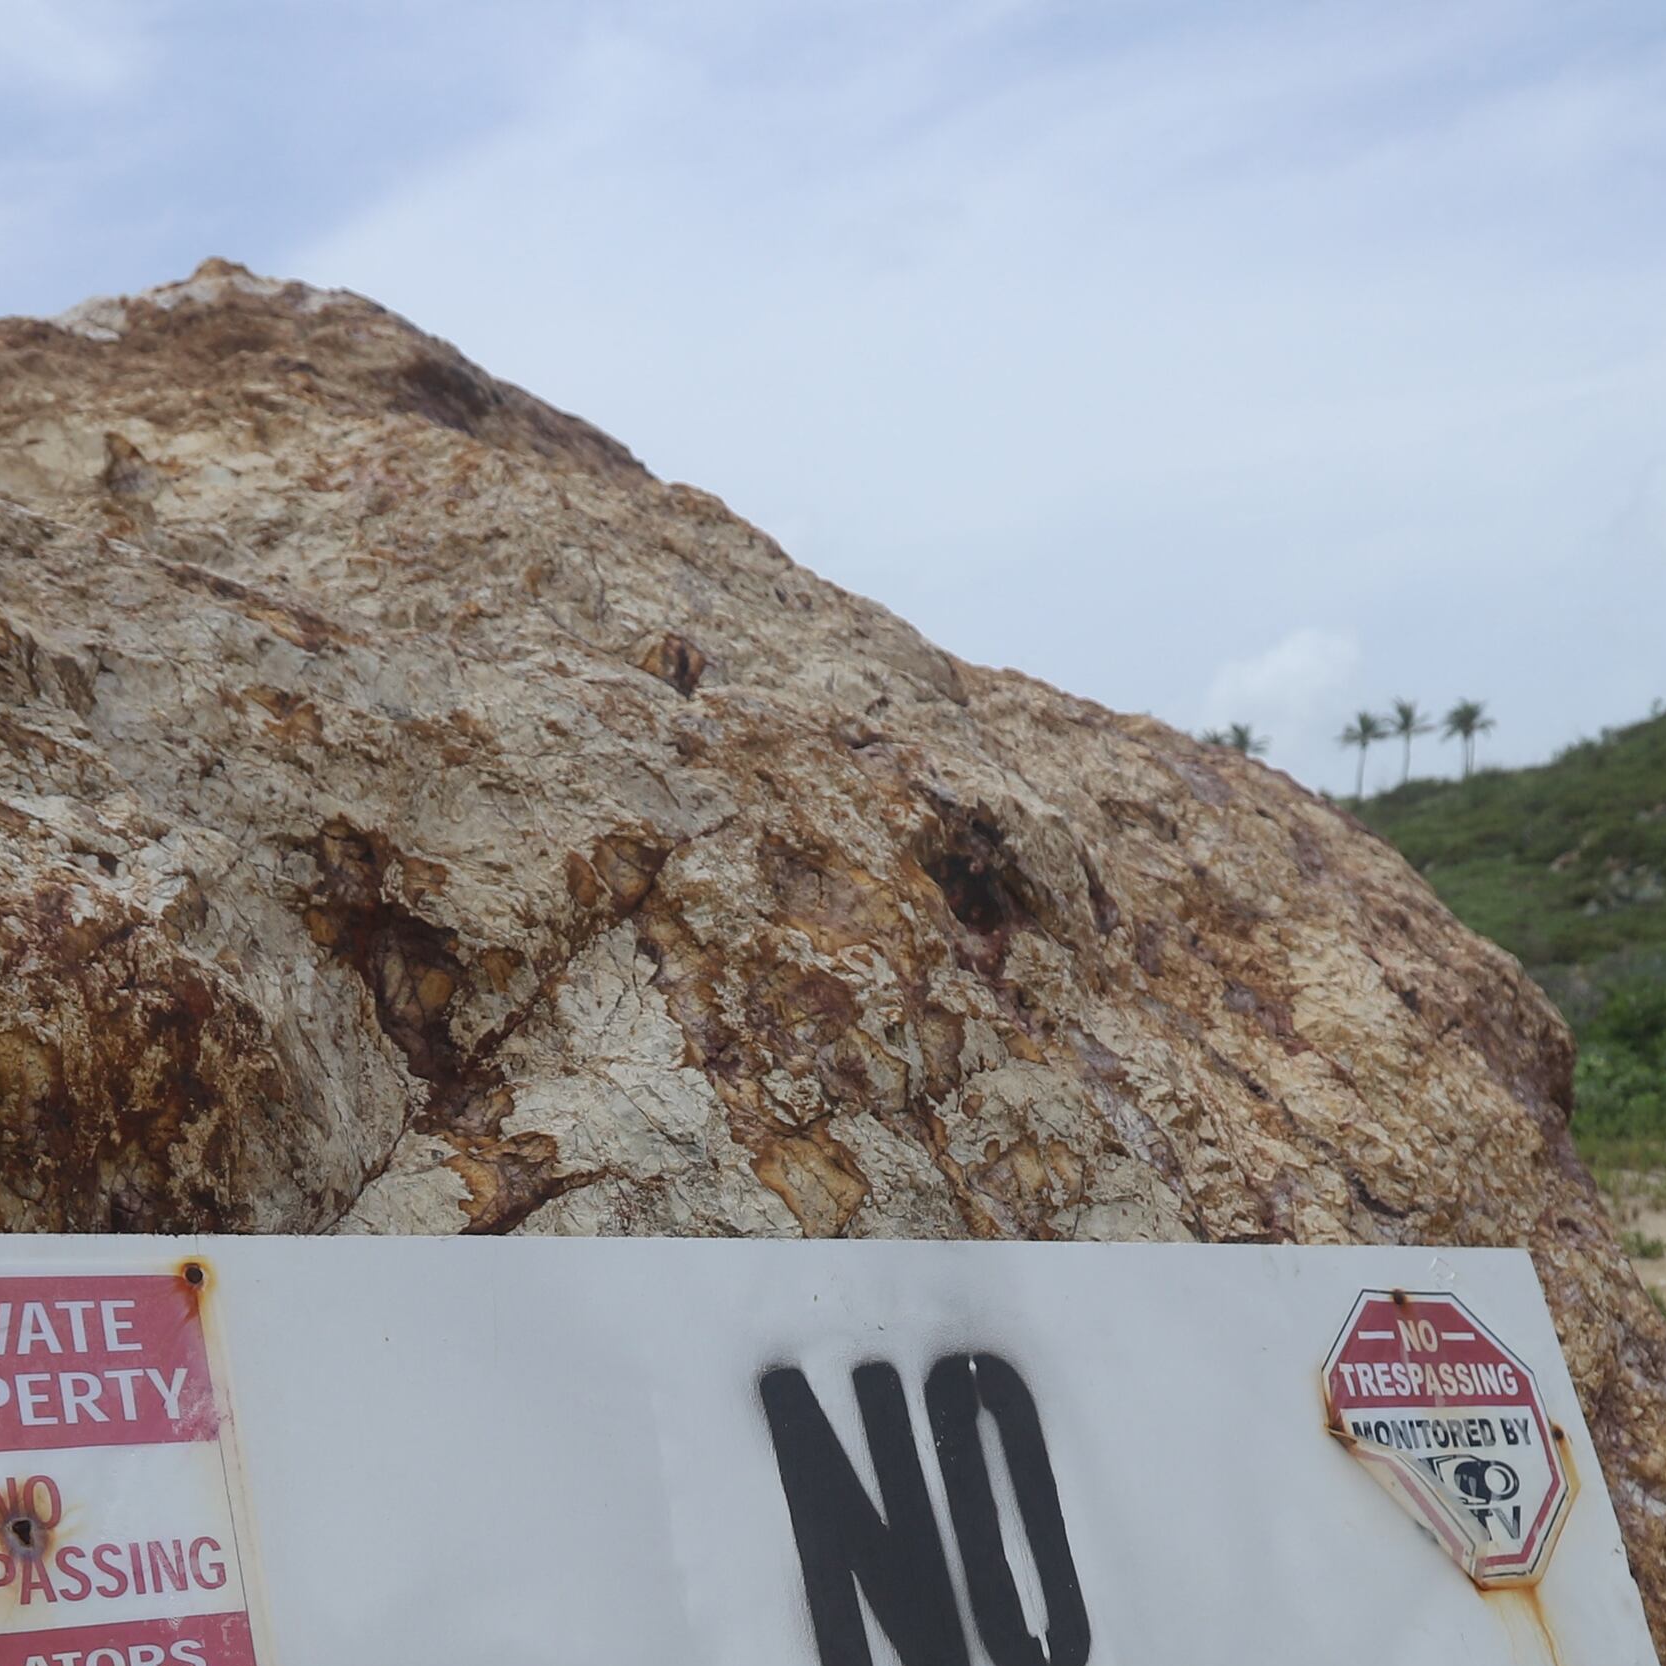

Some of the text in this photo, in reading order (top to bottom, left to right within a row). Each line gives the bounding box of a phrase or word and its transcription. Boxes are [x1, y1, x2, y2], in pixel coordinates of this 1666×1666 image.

[1397, 1319, 1439, 1352] NO
[1338, 1363, 1519, 1397] TRESPASSING
[1351, 1418, 1532, 1450] MONITORED BY
